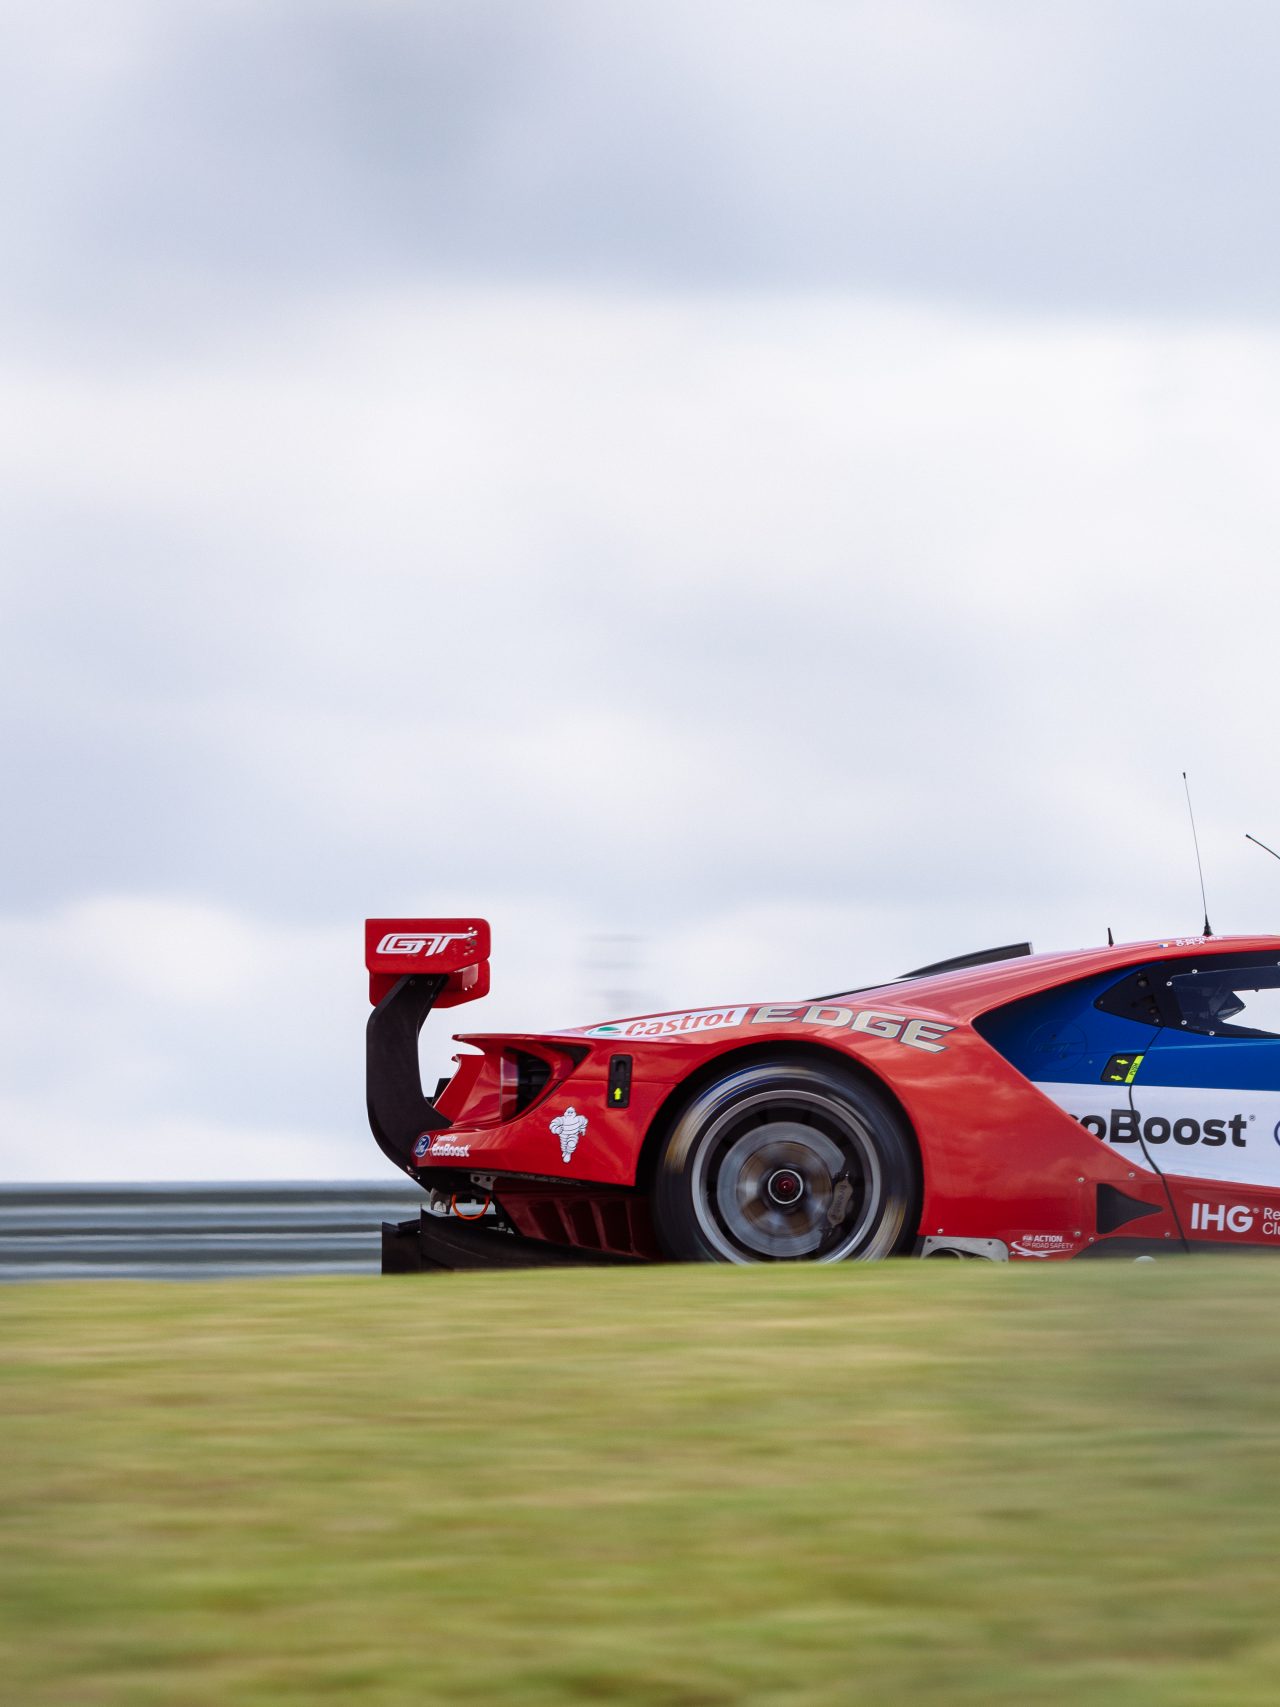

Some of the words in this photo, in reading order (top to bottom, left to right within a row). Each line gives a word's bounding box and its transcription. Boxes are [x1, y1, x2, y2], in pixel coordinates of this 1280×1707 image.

[376, 932, 477, 957] GT
[625, 1010, 734, 1036] Castrol
[751, 1005, 957, 1054] EDGE
[432, 1144, 470, 1157] EcoBoost
[1191, 1203, 1253, 1232] IHG
